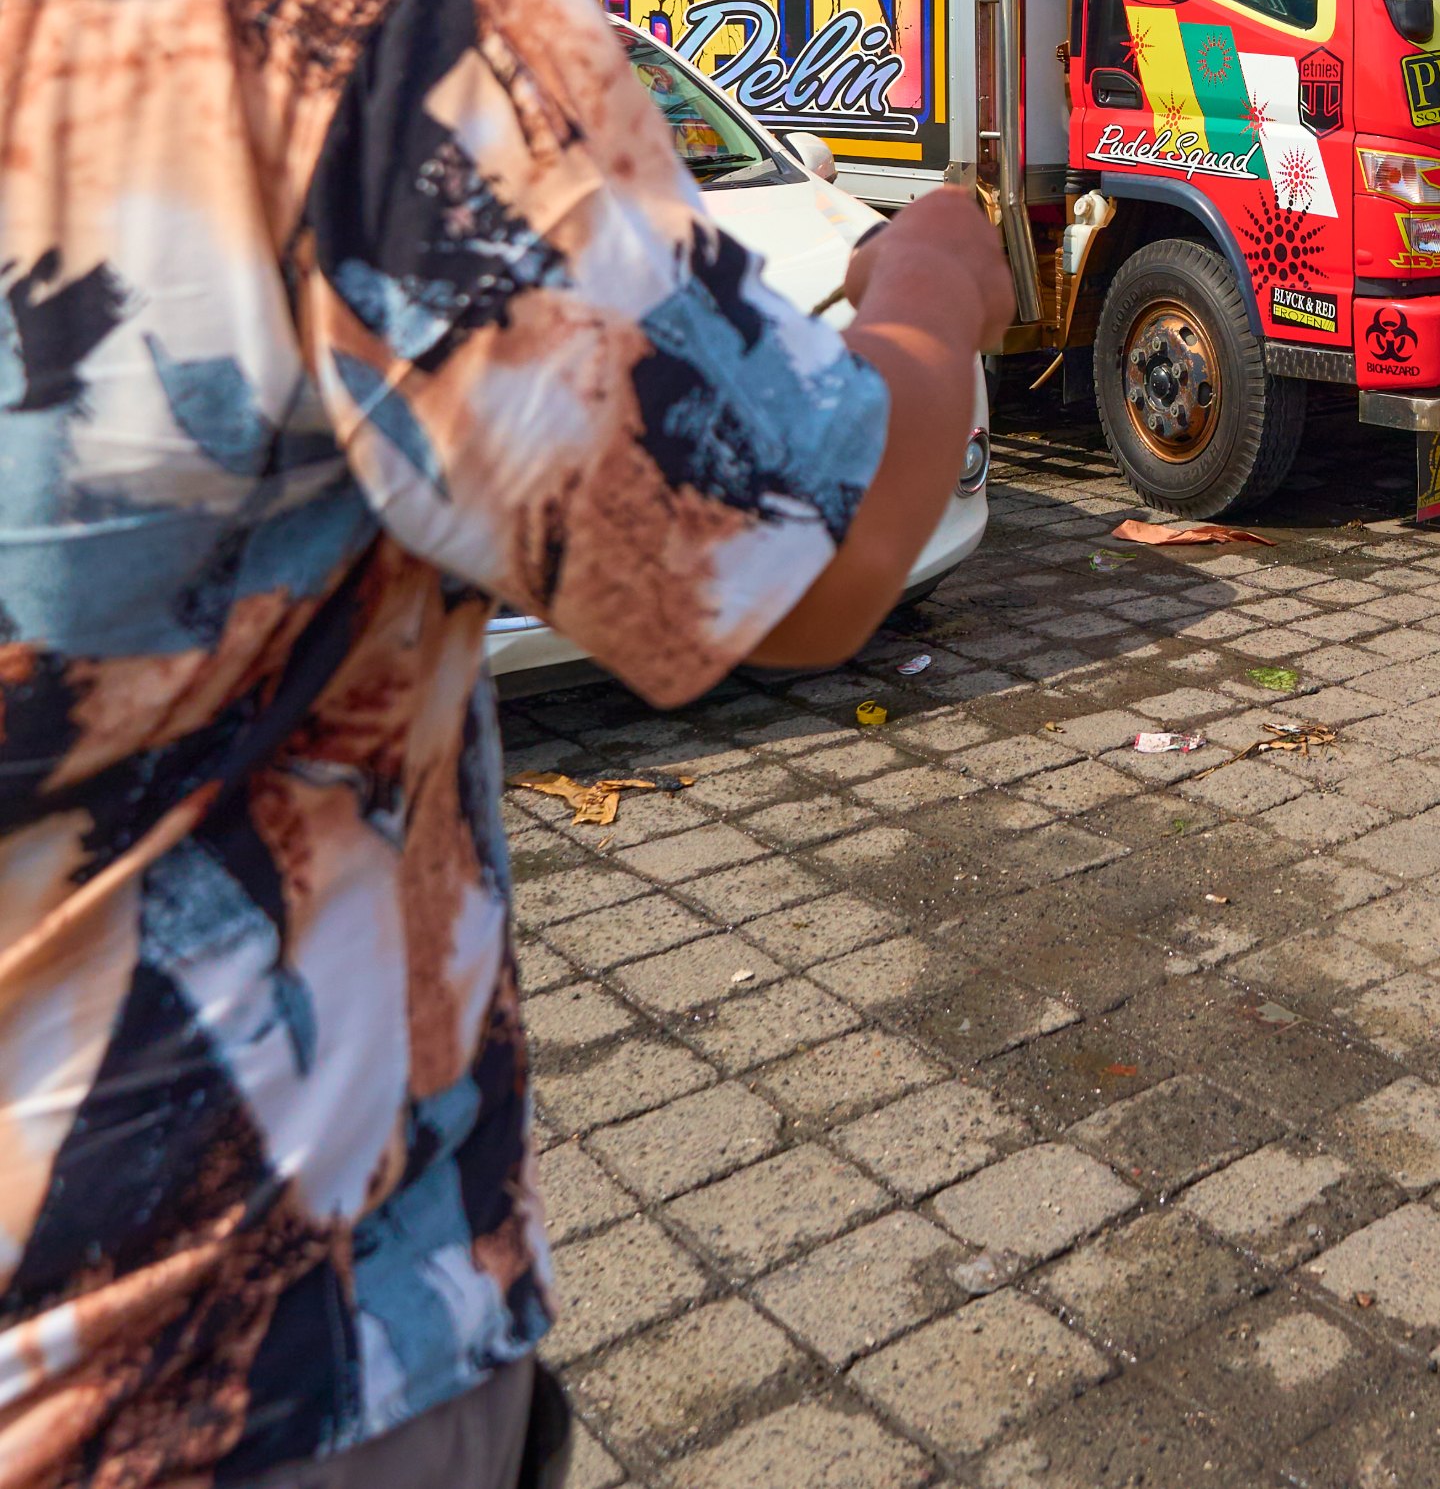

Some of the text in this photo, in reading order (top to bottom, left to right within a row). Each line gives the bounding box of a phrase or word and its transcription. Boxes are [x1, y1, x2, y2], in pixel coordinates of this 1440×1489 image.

[1302, 59, 1339, 78] etnies
[1095, 124, 1260, 180] Pudel Squad
[1305, 297, 1315, 314] &
[1315, 299, 1336, 319] RED
[1366, 361, 1421, 377] BIOHAZARD
